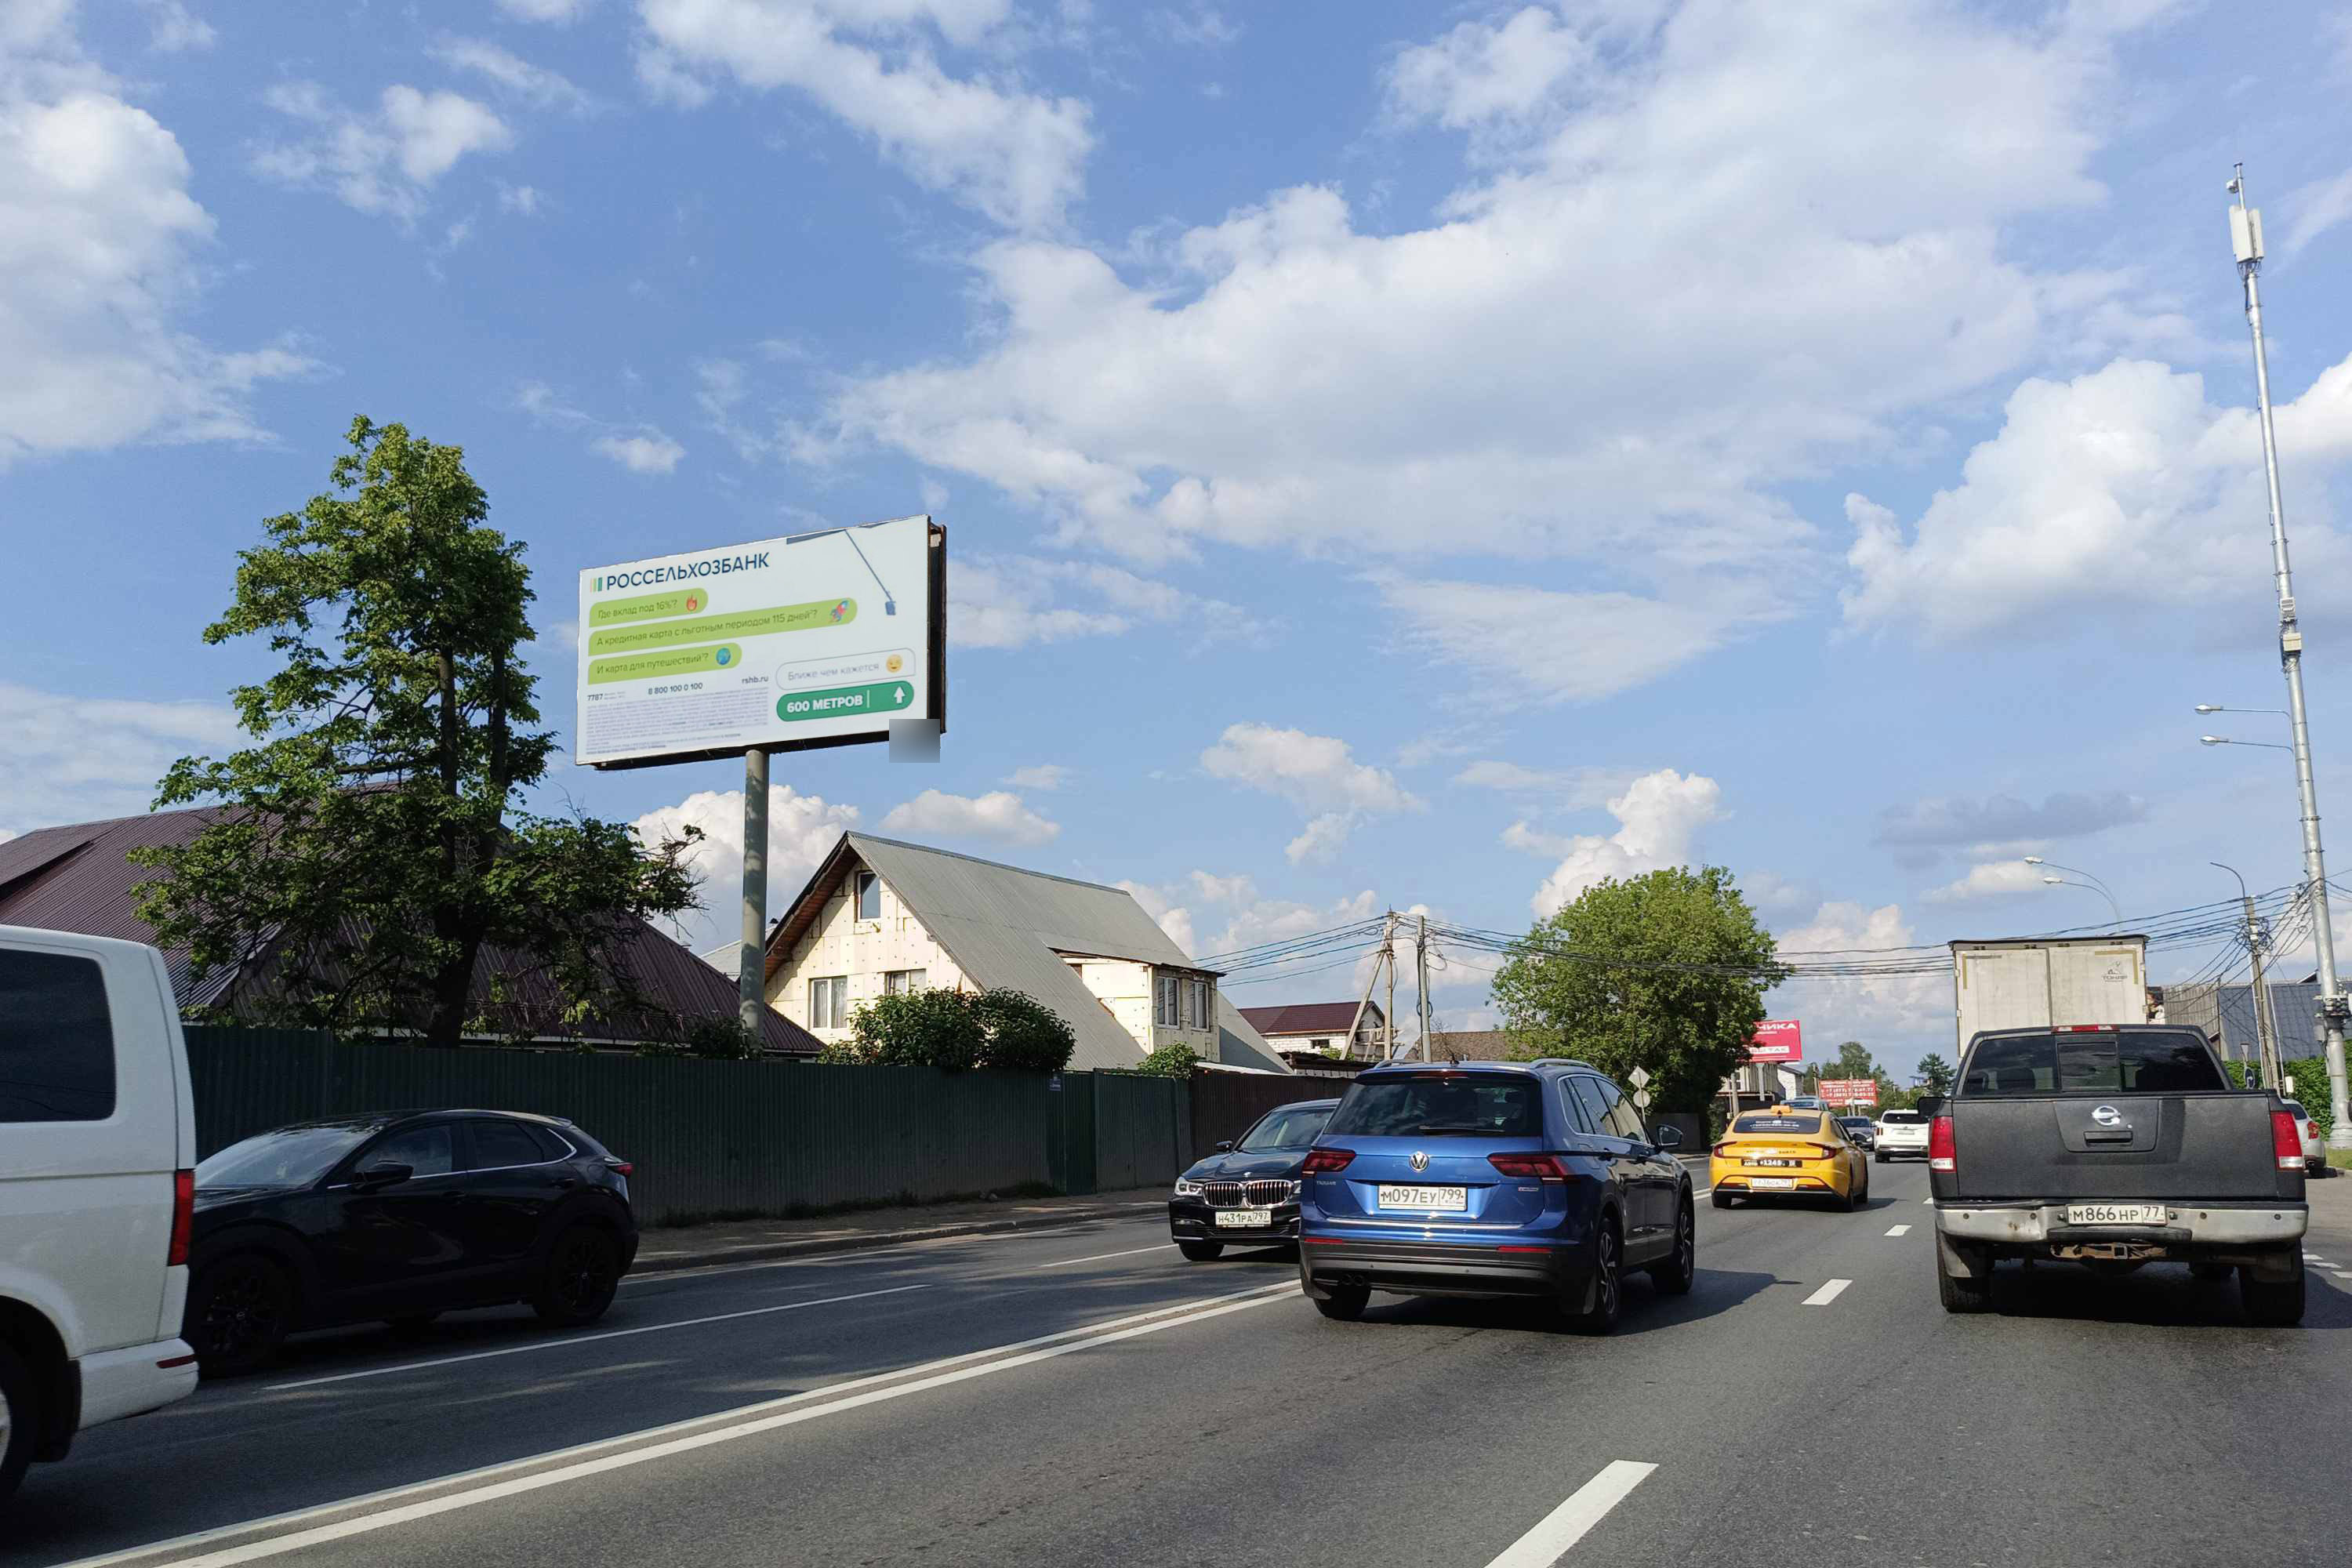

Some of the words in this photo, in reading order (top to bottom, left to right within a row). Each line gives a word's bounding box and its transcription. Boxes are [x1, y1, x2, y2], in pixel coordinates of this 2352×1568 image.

[607, 552, 770, 590] РОССЕЛЬХОЗБАНК
[598, 609, 612, 619] Где
[613, 607, 637, 617] вклад
[639, 604, 655, 614] под
[597, 637, 604, 646] А
[604, 633, 648, 645] кредитная
[649, 630, 673, 640] карта
[681, 623, 724, 636] льготным
[725, 617, 771, 630] периодом
[772, 614, 785, 624] 115
[597, 665, 604, 674] И
[605, 664, 628, 674] карта
[629, 662, 645, 672] для
[788, 671, 818, 681] Ближе
[821, 669, 838, 677] чем
[840, 663, 880, 675] кажется
[742, 675, 769, 684] rshb.ru
[654, 685, 668, 694] 800
[670, 684, 683, 692] 100
[587, 692, 604, 702] 7787
[787, 701, 810, 713] 600
[812, 695, 863, 711] МЕТРОВ
[1382, 1188, 1437, 1203] М097ЕУ
[1439, 1188, 1462, 1200] 799
[1218, 1213, 1253, 1223] Н431РА
[1254, 1211, 1268, 1220] 797
[2073, 1207, 2139, 1221] М866НР
[2143, 1206, 2159, 1218] 77
